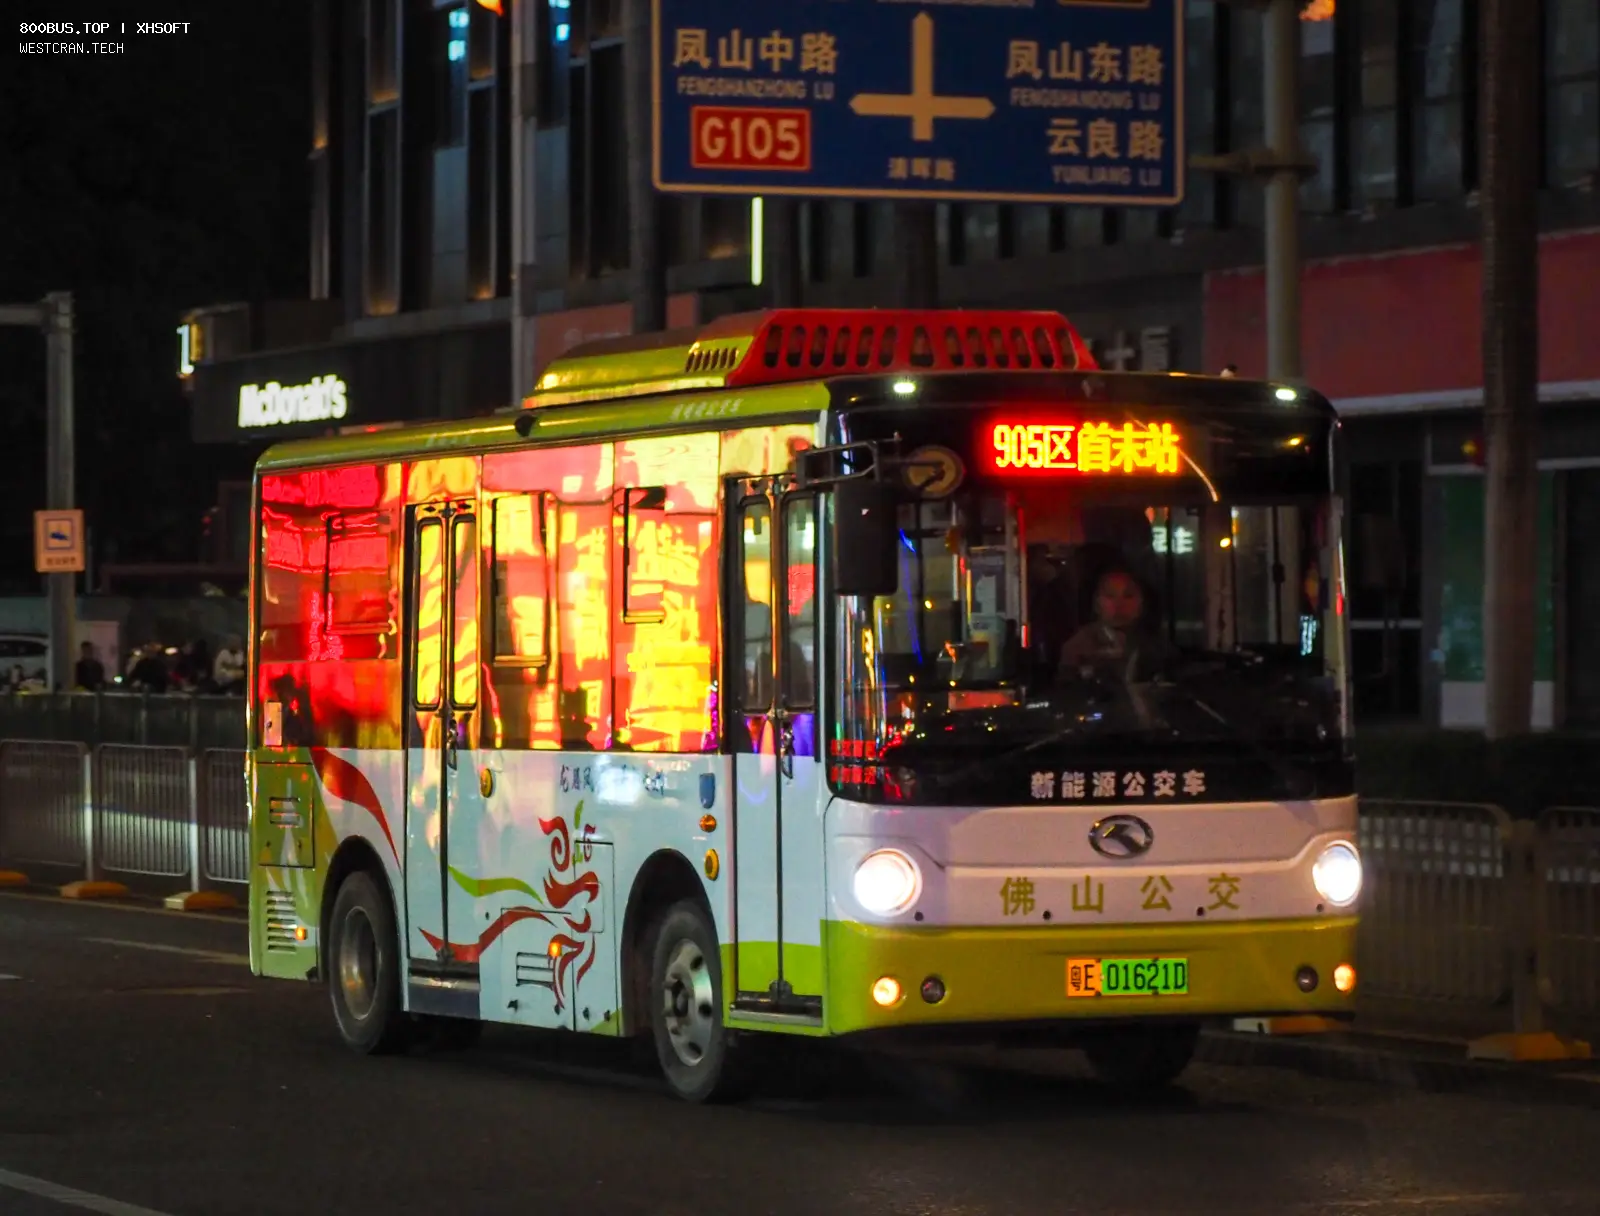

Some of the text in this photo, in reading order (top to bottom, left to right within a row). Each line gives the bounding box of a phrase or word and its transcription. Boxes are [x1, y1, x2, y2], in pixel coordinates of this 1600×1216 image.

[672, 28, 838, 74] 凤山中路
[1005, 40, 1163, 86] 凤山东路
[813, 80, 835, 100] LU
[701, 116, 801, 161] G105
[1046, 117, 1164, 161] 云良路
[237, 373, 347, 429] McDonald's
[1031, 768, 1206, 799] 新能源公交车
[1000, 872, 1242, 917] 佛山公交
